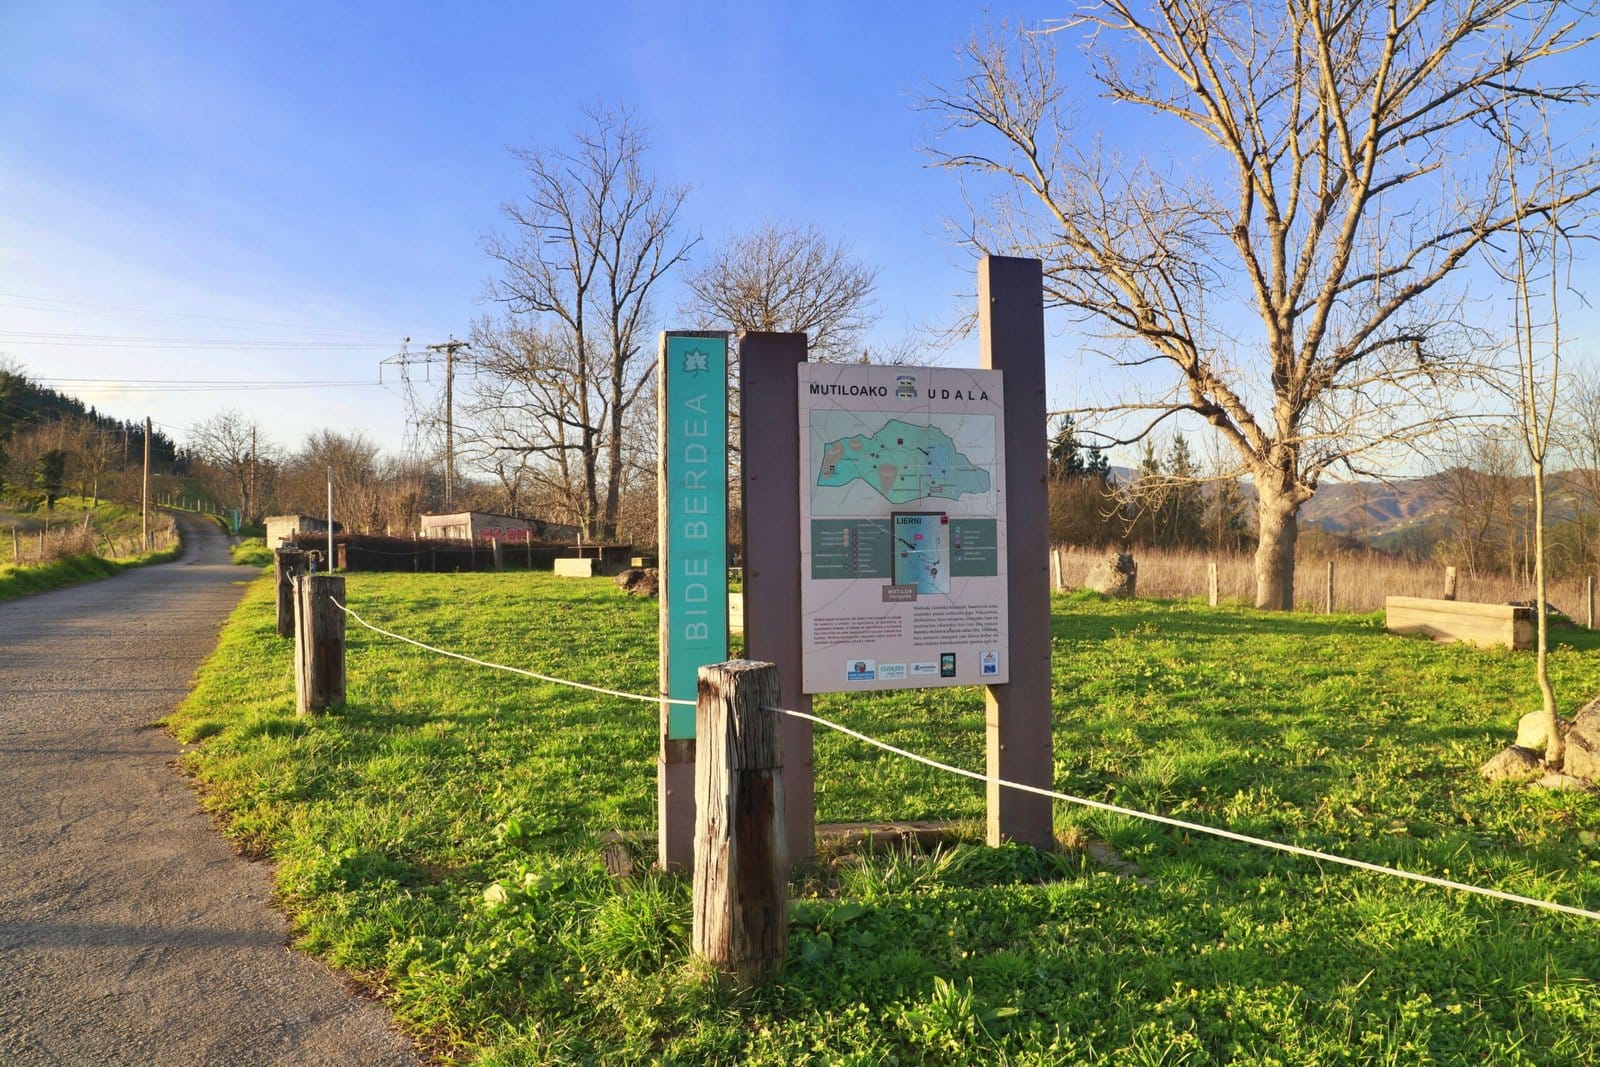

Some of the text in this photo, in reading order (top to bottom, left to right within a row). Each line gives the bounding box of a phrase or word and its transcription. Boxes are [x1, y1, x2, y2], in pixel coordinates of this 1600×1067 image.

[809, 383, 989, 401] MUTILOAKO UDALA
[684, 393, 709, 640] BIDE BERDEA
[896, 517, 922, 526] LIERNI
